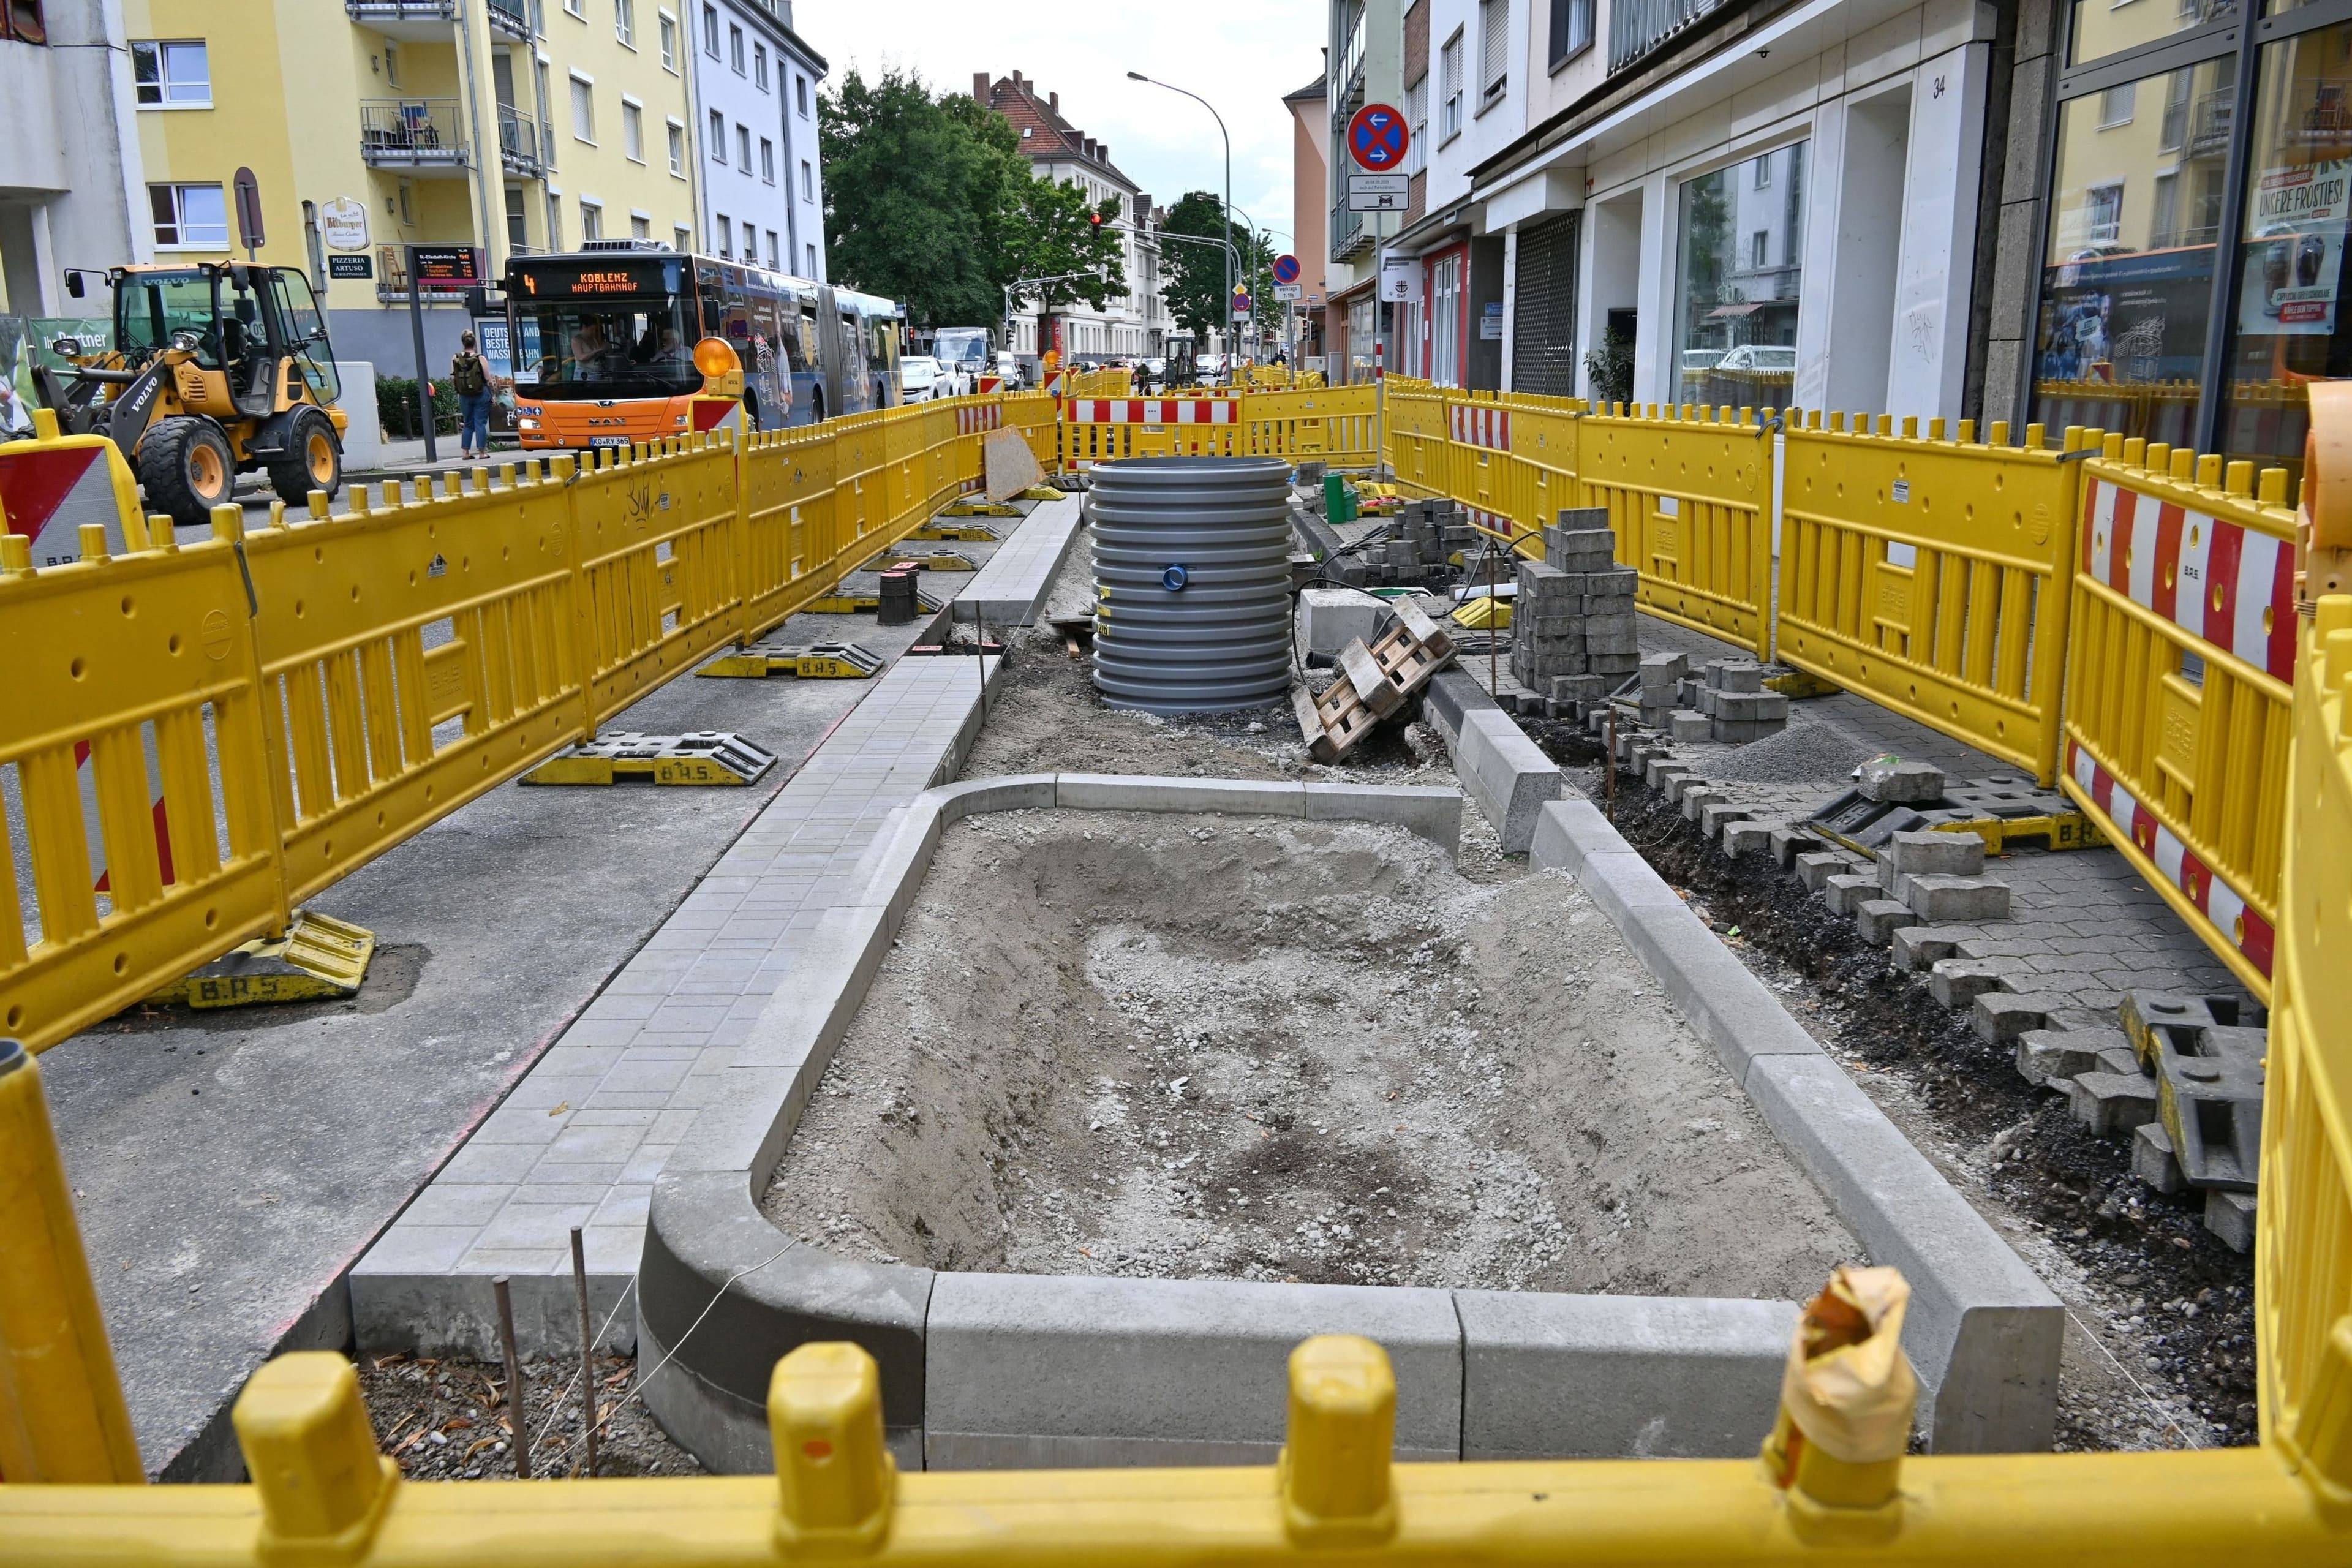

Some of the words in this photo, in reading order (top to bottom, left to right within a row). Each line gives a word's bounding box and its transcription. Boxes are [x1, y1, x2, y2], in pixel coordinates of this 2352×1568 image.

[1934, 75, 1945, 99] 34
[2259, 189, 2294, 217] UNSERE
[2294, 179, 2343, 211] FROSTIES!
[327, 217, 362, 230] Bitburger
[524, 274, 535, 294] 4
[581, 273, 628, 283] KOBLENZ
[571, 282, 638, 292] HAUPTBAHNHOF
[131, 377, 157, 412] VOLVO
[589, 417, 627, 426] MAN
[616, 437, 629, 445] 365
